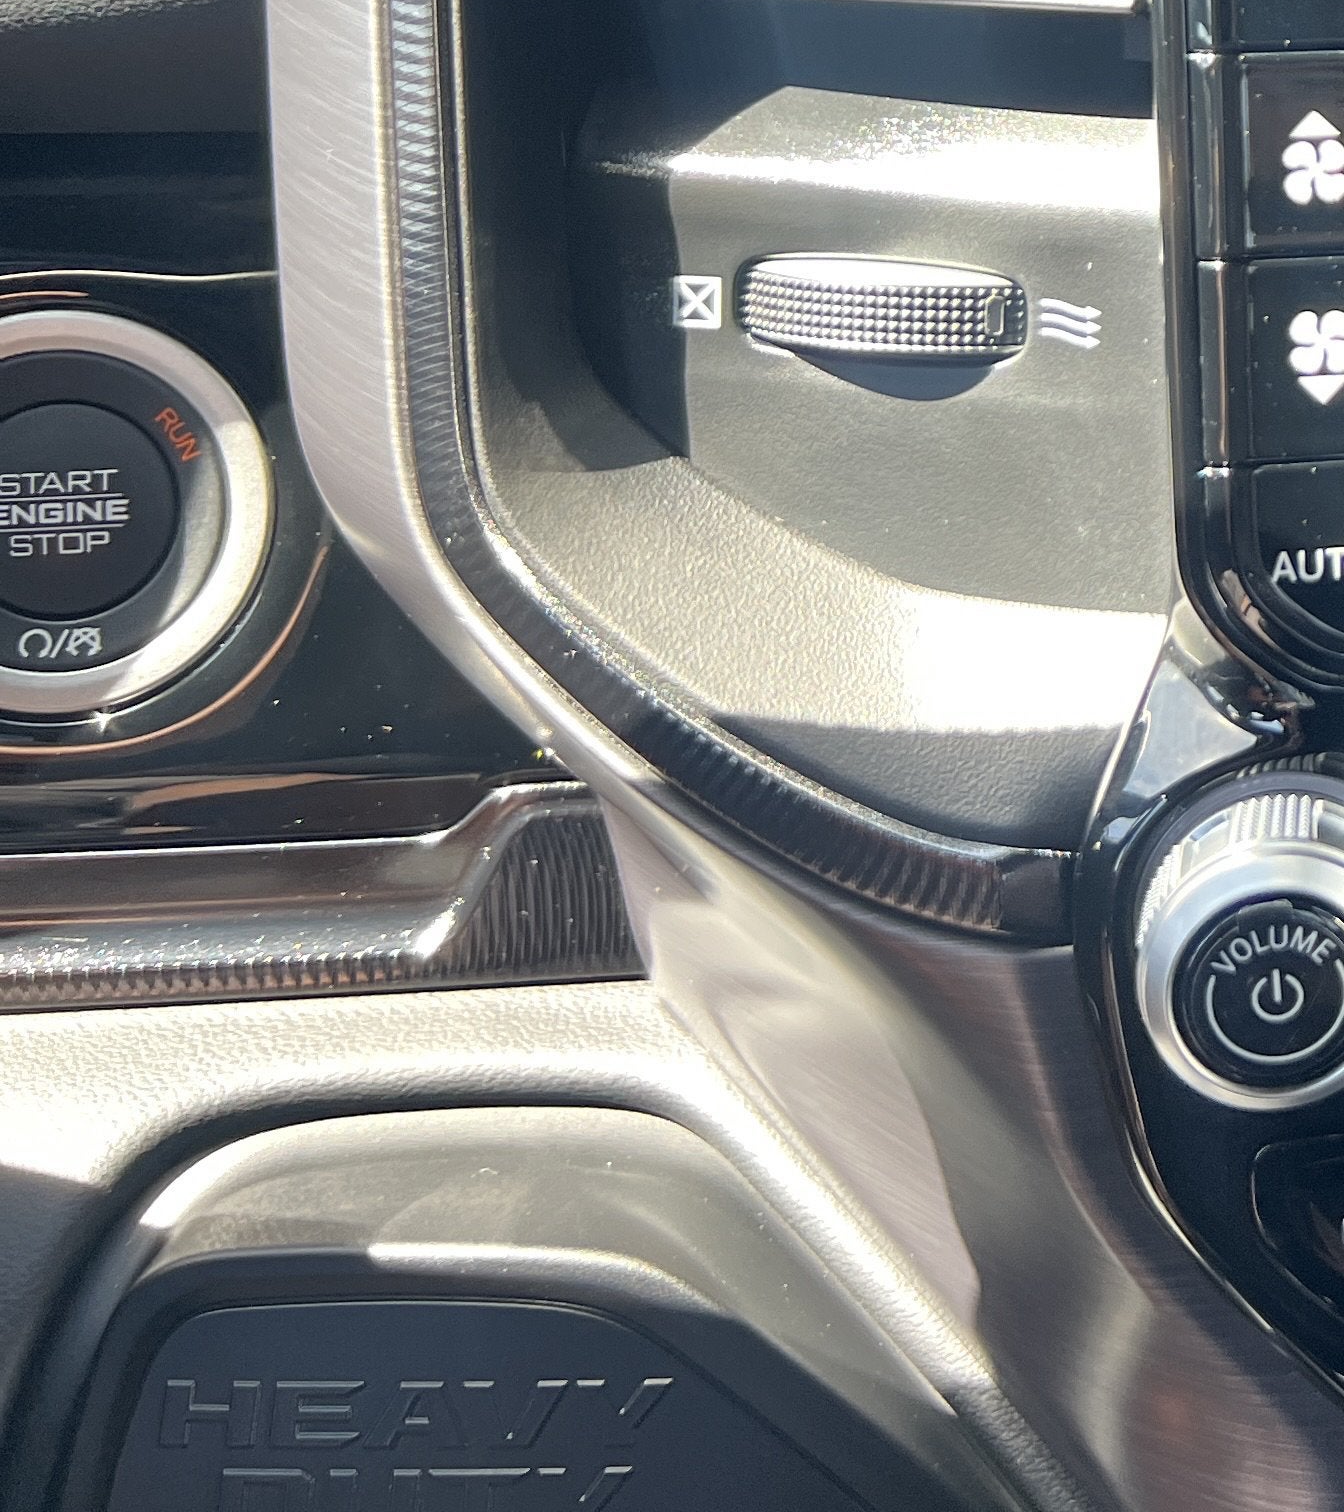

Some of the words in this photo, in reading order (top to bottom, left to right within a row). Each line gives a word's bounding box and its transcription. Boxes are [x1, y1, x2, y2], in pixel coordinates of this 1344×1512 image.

[154, 407, 202, 462] RUN
[9, 530, 111, 557] STOP
[1212, 924, 1336, 977] VOLUME
[158, 1377, 675, 1449] HEAVY
